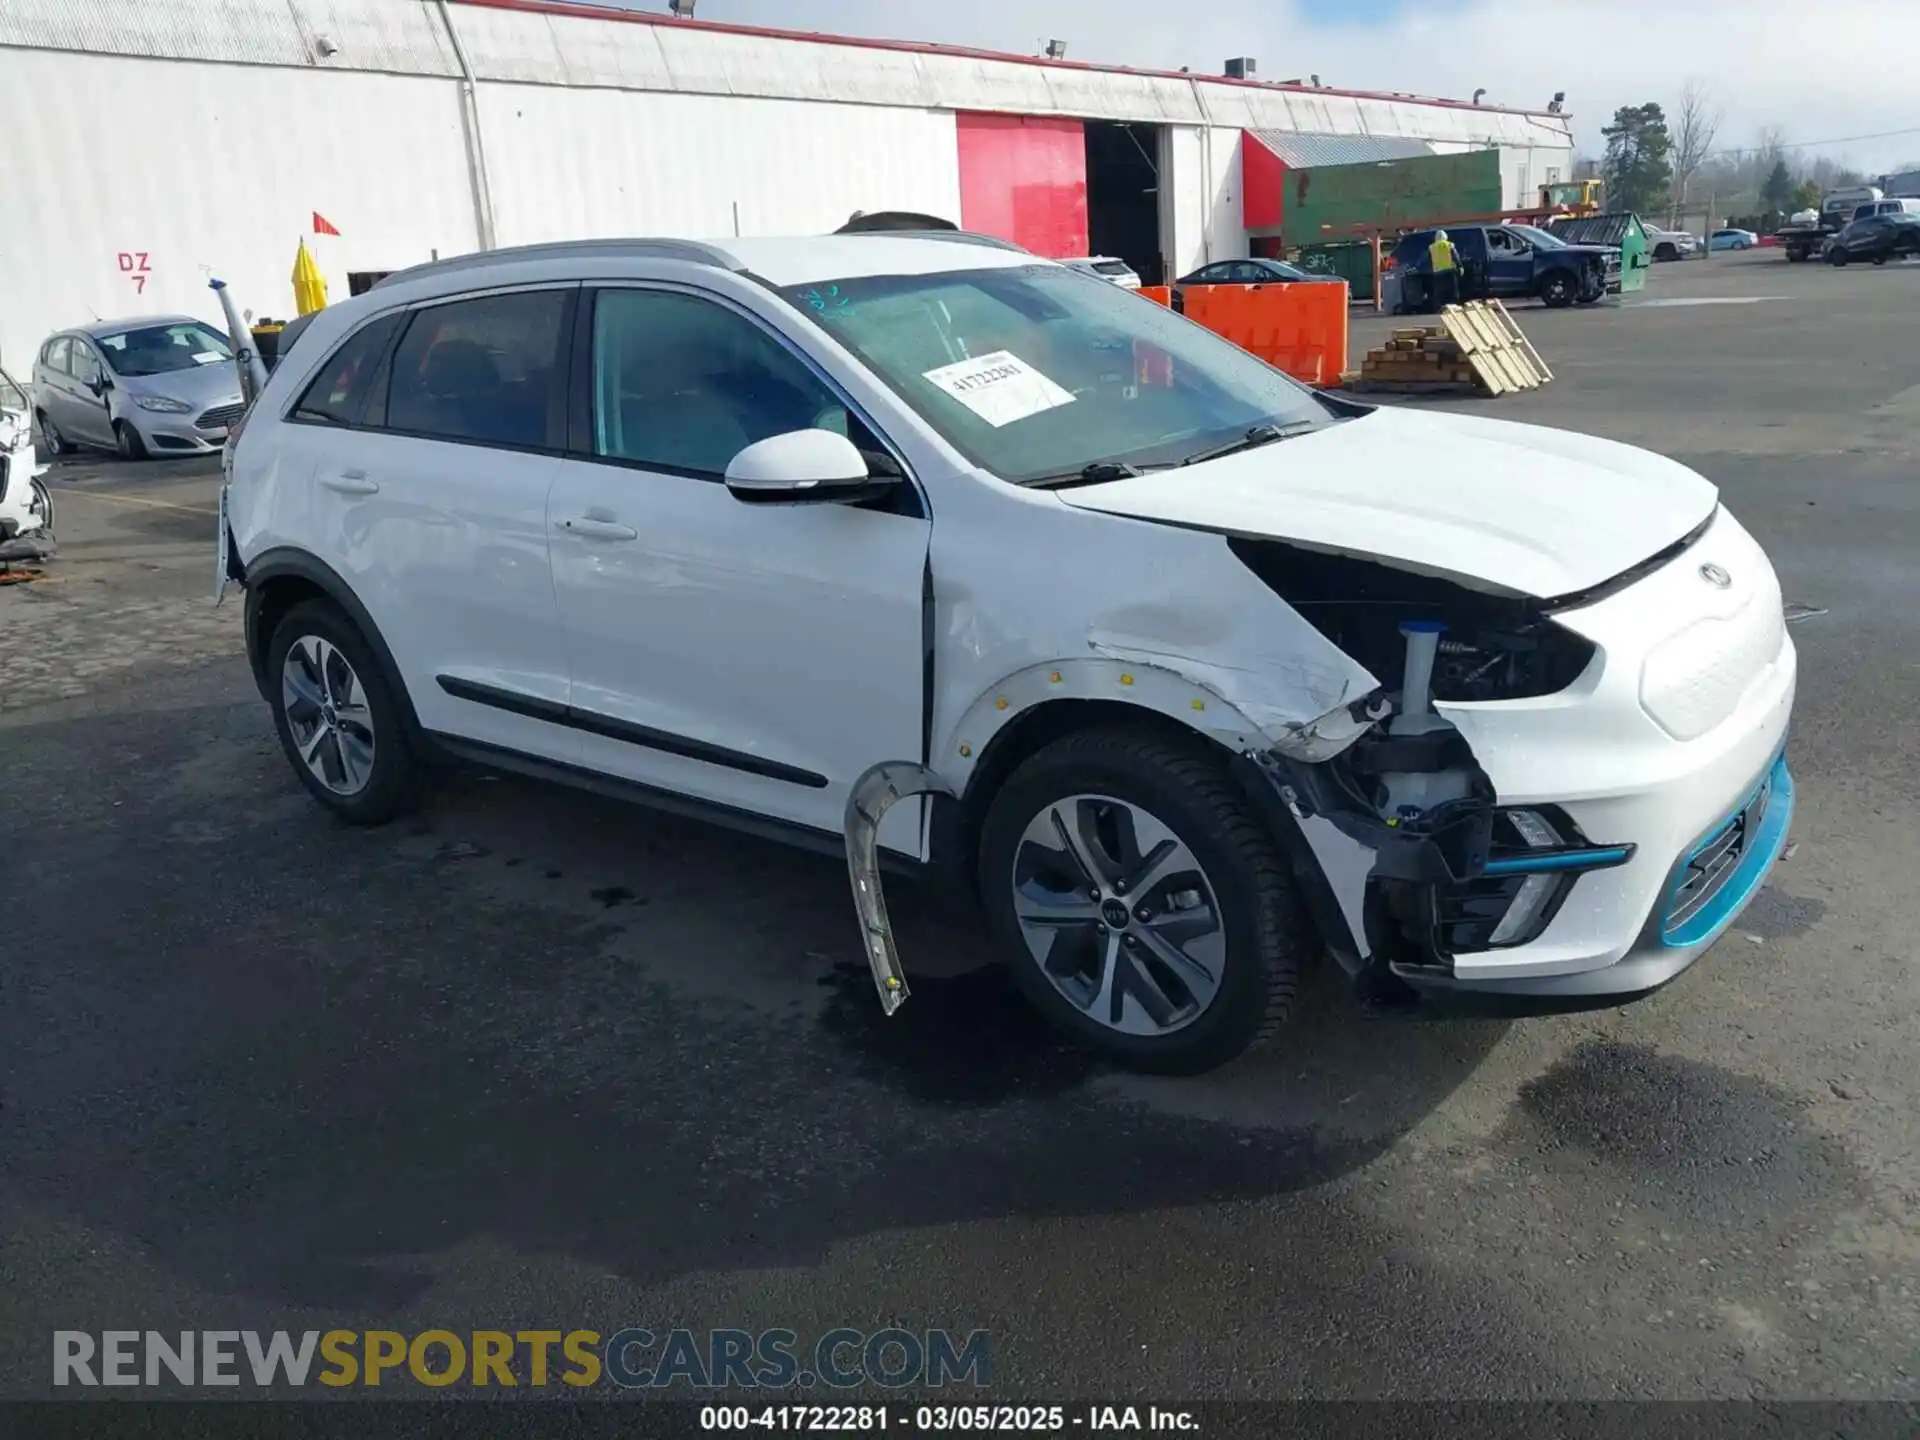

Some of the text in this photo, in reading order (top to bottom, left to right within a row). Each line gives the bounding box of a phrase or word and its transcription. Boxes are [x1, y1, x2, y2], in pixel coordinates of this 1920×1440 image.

[118, 252, 152, 271] DZ
[131, 275, 146, 294] 7
[952, 364, 1022, 391] 41722281
